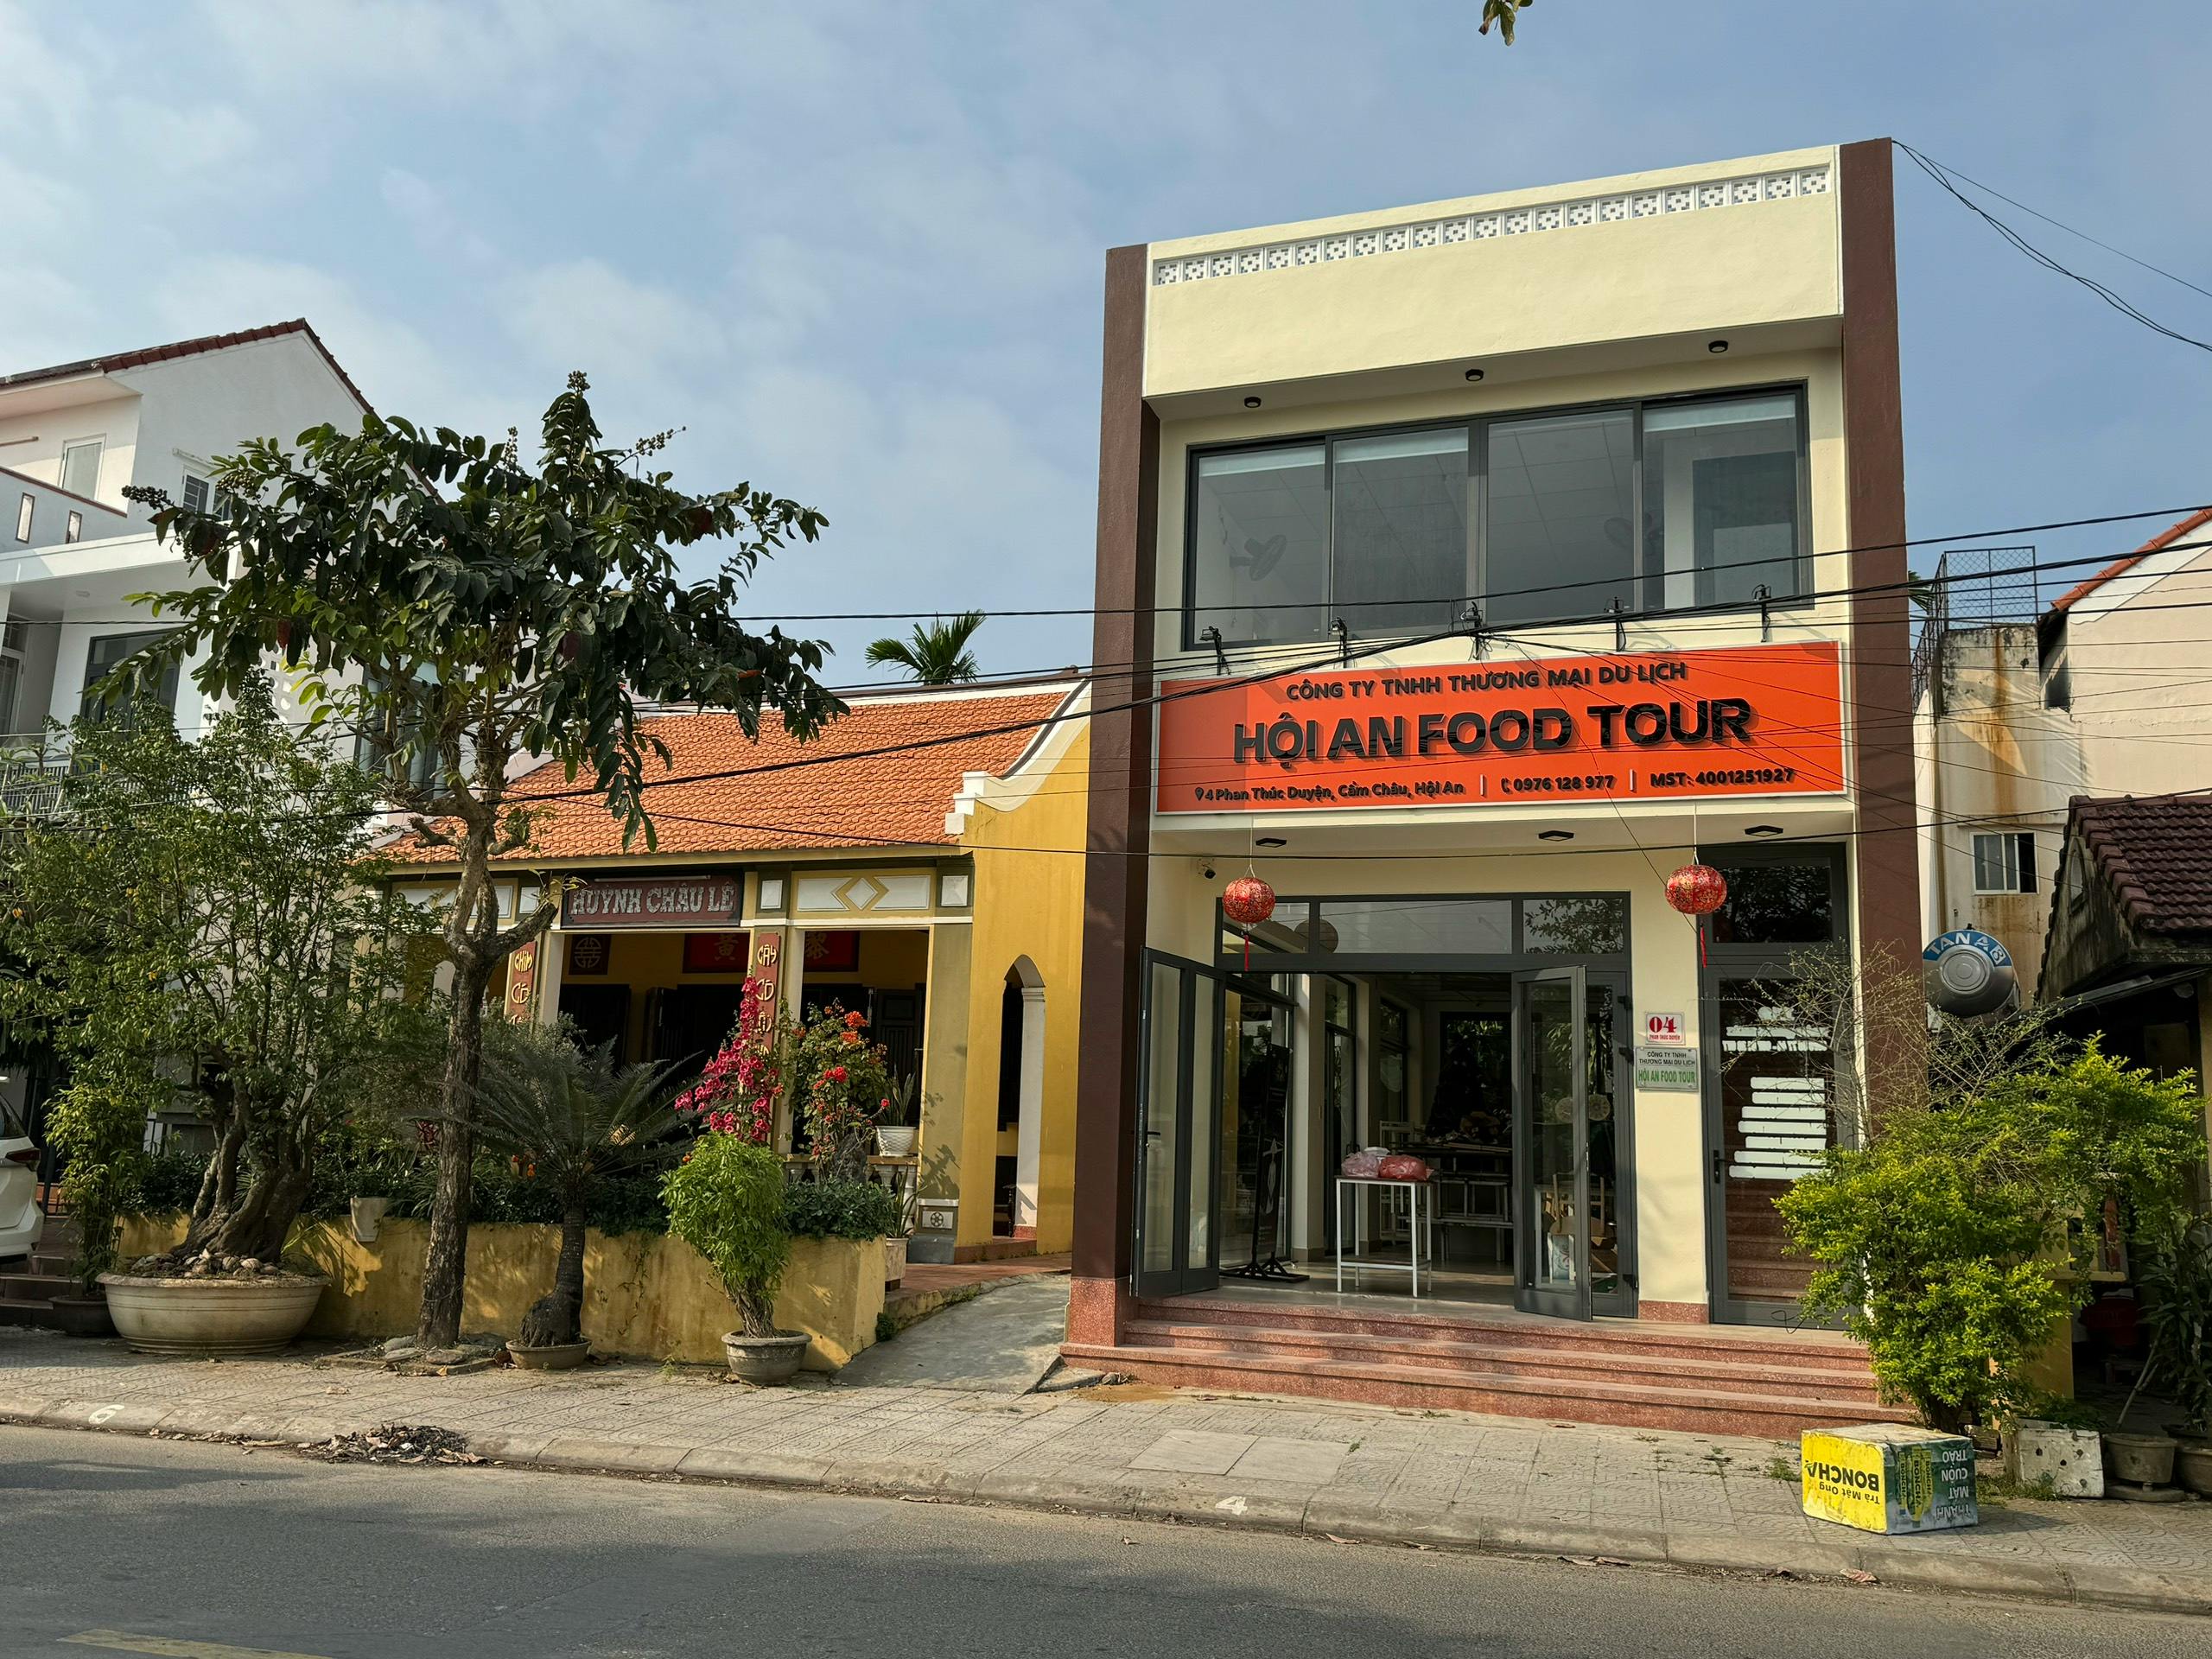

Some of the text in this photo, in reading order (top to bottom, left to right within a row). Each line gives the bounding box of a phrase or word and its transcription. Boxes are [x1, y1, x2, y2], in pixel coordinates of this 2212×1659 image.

[1287, 679, 1343, 700] CÔNG
[1349, 680, 1375, 697] TY
[1382, 677, 1440, 696] TNHH
[1447, 671, 1539, 691] THƯƠNG
[1599, 665, 1630, 683] DU
[1234, 697, 1753, 769] HỘI AN FOOD TOUR
[1514, 775, 1615, 791] 0976 128 977
[1695, 768, 1796, 785] 4001251927
[1205, 788, 1214, 801] 4
[1216, 787, 1249, 801] Phan
[1251, 785, 1286, 800] Thúc
[1372, 782, 1413, 799] Châu,
[1414, 780, 1440, 798] Hội
[1442, 781, 1465, 795] An
[646, 881, 704, 914] CHÂU
[708, 880, 735, 912] LÊ
[1649, 1016, 1677, 1033] 04
[1650, 1071, 1659, 1082] AN
[1661, 1071, 1677, 1083] FOOD
[1678, 1071, 1695, 1084] TOUR
[1805, 1459, 1880, 1492] BONCHA
[1819, 1481, 1839, 1495] Ong
[1215, 1496, 1248, 1516] 4
[1864, 1491, 1880, 1505] Trà
